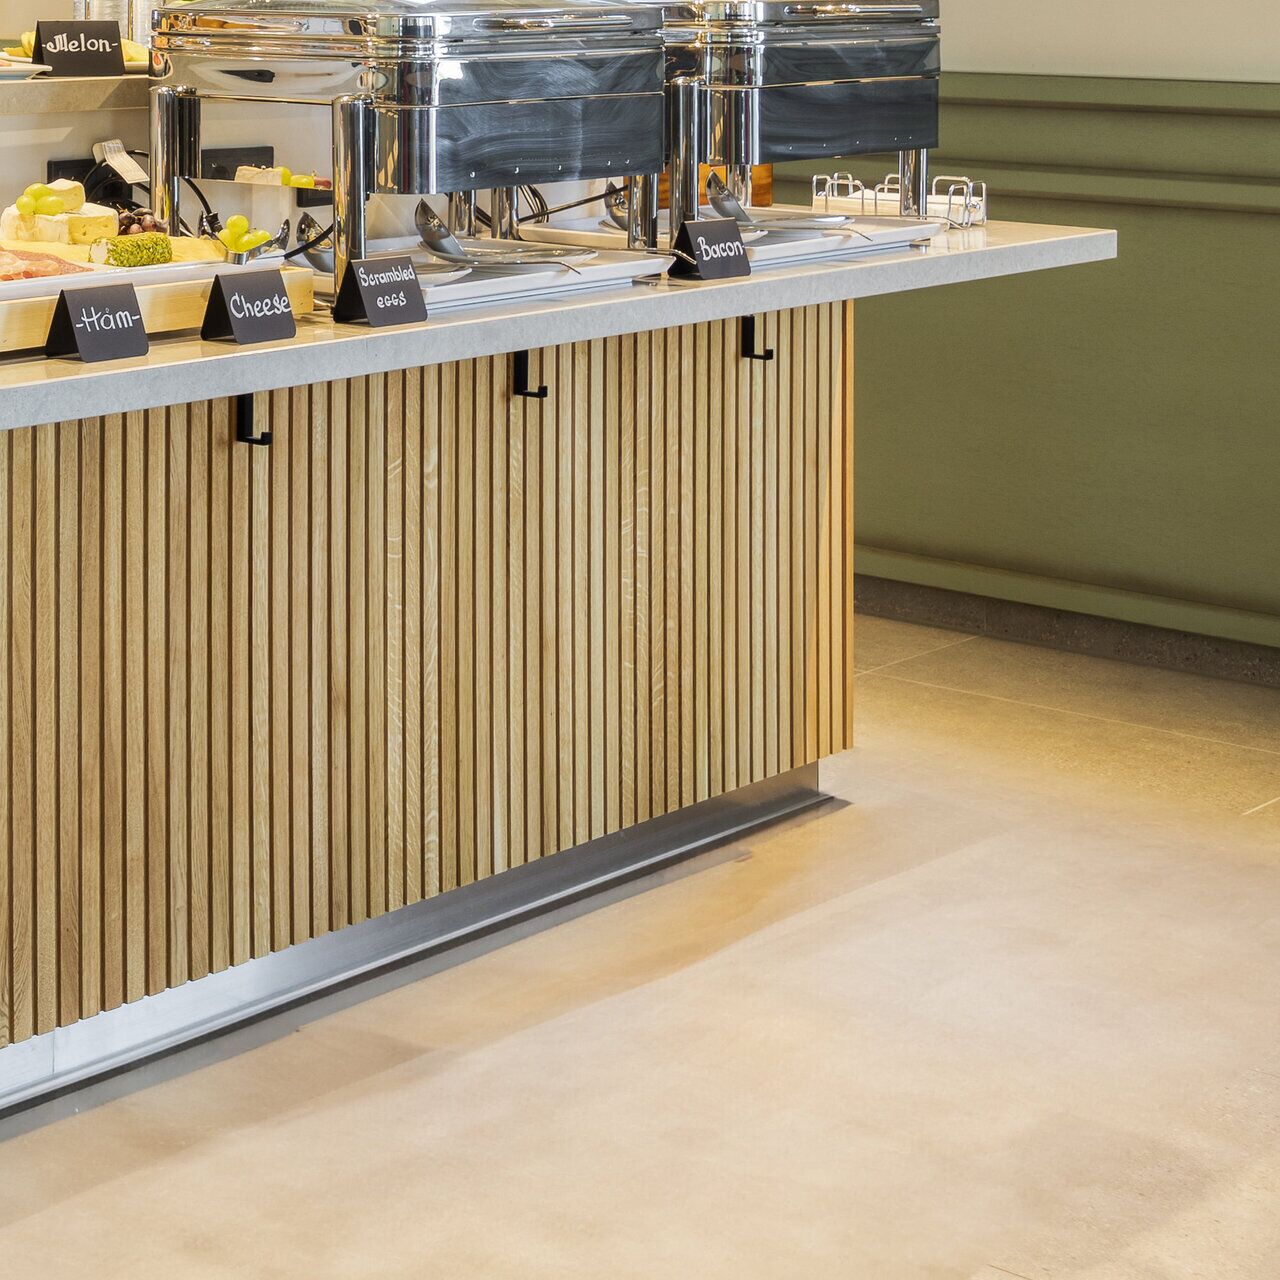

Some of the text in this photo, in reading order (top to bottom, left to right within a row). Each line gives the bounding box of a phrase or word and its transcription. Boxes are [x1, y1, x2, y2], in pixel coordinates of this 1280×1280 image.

[46, 32, 112, 53] Melon
[697, 236, 744, 261] Bacon
[358, 264, 416, 287] Scrambled
[229, 292, 291, 319] Cheese
